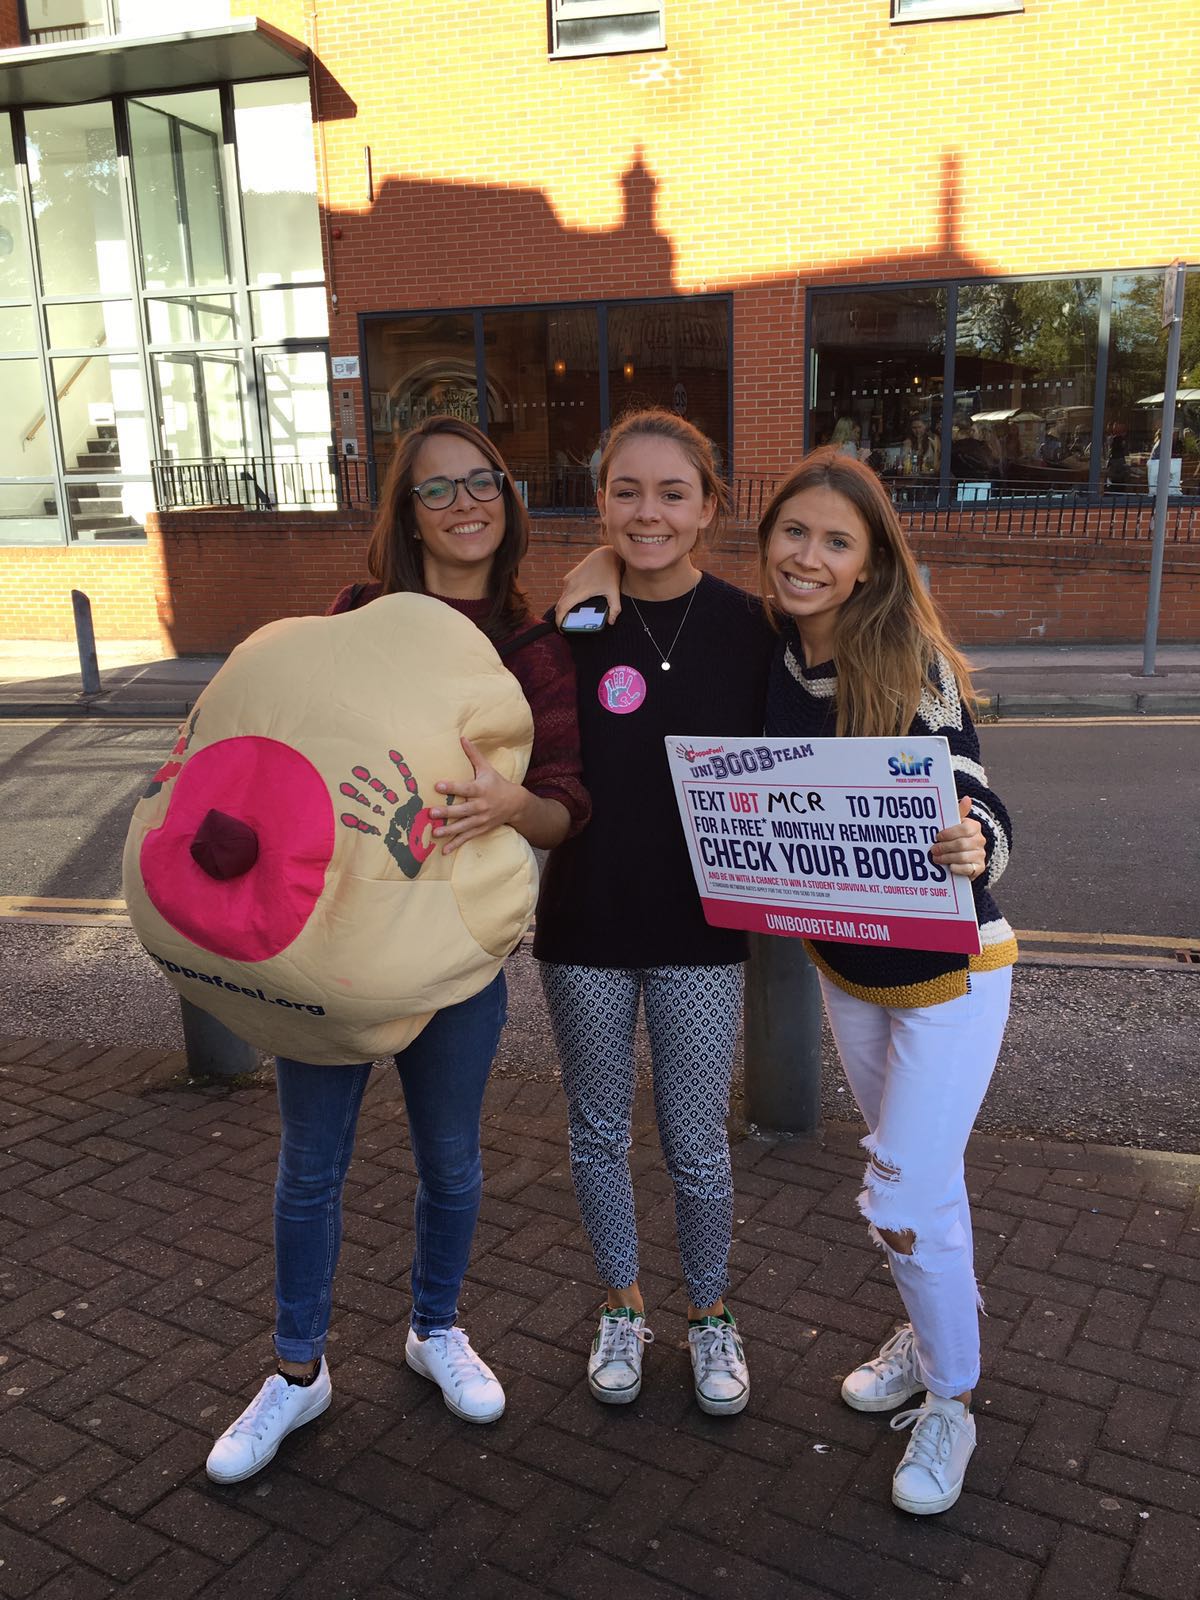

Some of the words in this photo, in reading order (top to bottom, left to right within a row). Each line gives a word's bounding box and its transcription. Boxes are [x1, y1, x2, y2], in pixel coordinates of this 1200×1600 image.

[690, 763, 713, 778] UNI
[709, 746, 775, 779] BOOB
[773, 744, 814, 762] TEAM
[888, 756, 934, 777] Surf
[688, 790, 726, 811] TEXT
[729, 792, 759, 813] UBT
[768, 791, 825, 814] MCR
[846, 796, 870, 818] TO
[873, 796, 937, 819] 70500
[694, 816, 718, 833] FOR
[721, 818, 730, 835] A
[771, 821, 834, 841] MONTHLY
[839, 824, 917, 844] REMINDER
[919, 826, 939, 844] TO
[700, 837, 777, 872] CHECK
[778, 842, 850, 877] YOUR
[853, 847, 947, 882] BOOBS
[708, 871, 720, 880] AND
[720, 872, 728, 881] BE
[735, 874, 750, 883] WITH
[756, 876, 780, 886] CHANCE
[780, 878, 789, 887] TO
[789, 879, 801, 888] WIN
[802, 880, 807, 888] A
[807, 880, 836, 891] STUDENT
[837, 882, 868, 893] SURVIVAL
[883, 885, 918, 896] COURTESY
[920, 887, 929, 896] OF
[765, 913, 890, 941] UNIBOOBTEAM.COM
